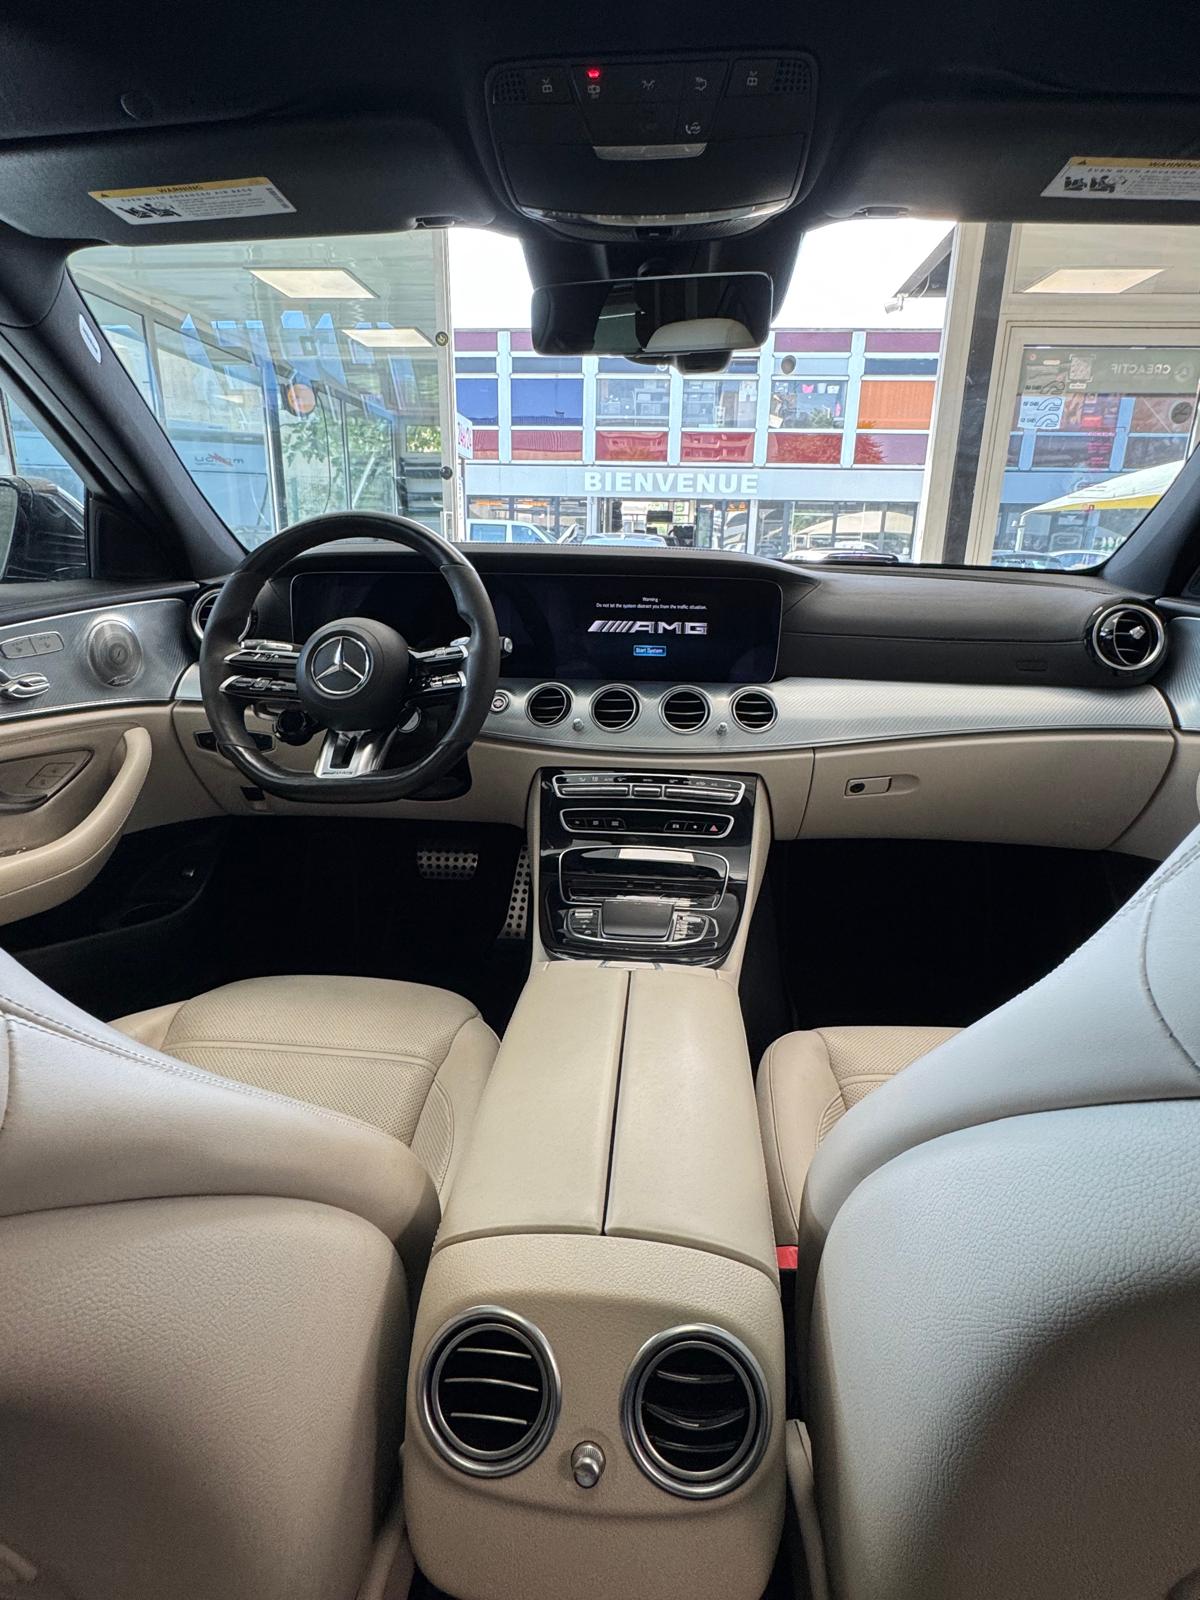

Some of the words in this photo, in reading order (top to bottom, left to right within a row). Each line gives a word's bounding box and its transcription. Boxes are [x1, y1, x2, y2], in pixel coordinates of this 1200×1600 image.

[584, 472, 758, 494] BIENVENUE
[629, 620, 708, 635] AMG
[647, 647, 663, 655] System
